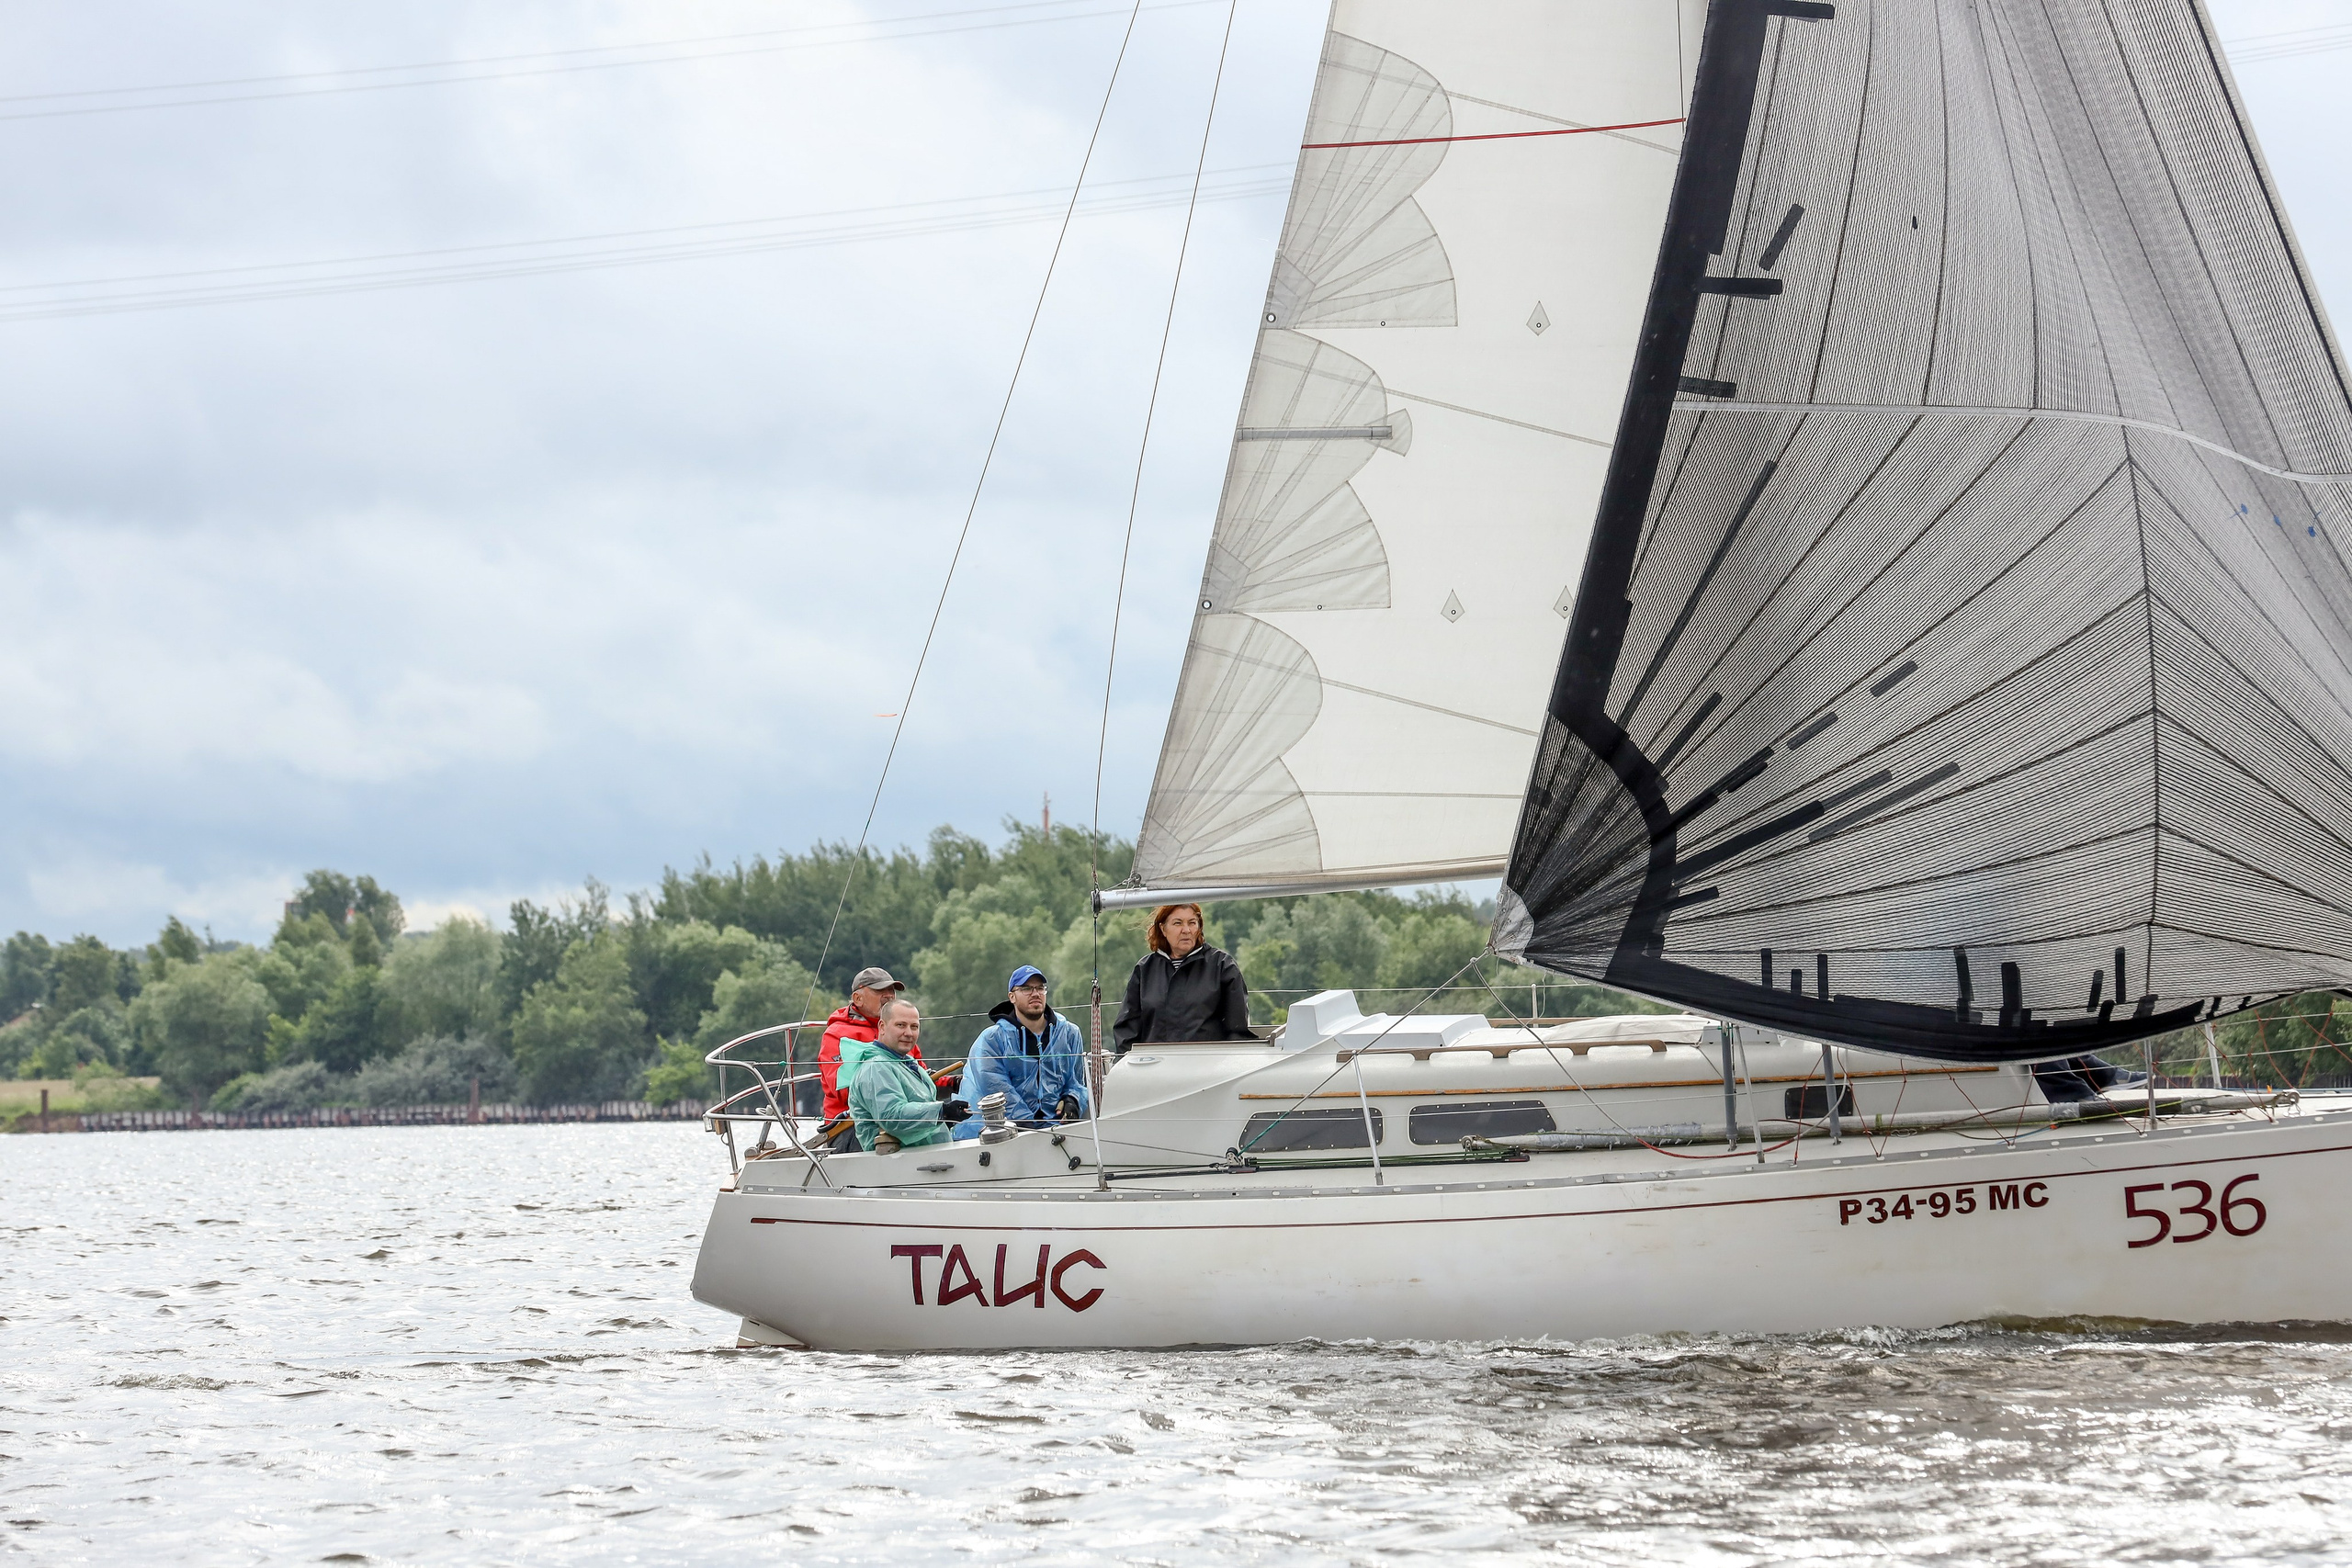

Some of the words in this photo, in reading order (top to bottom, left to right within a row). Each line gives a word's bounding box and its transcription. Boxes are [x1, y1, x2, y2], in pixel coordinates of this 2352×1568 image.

[1839, 1188, 1977, 1225] Р34-95
[1988, 1181, 2050, 1211] МС
[2124, 1173, 2267, 1249] 536
